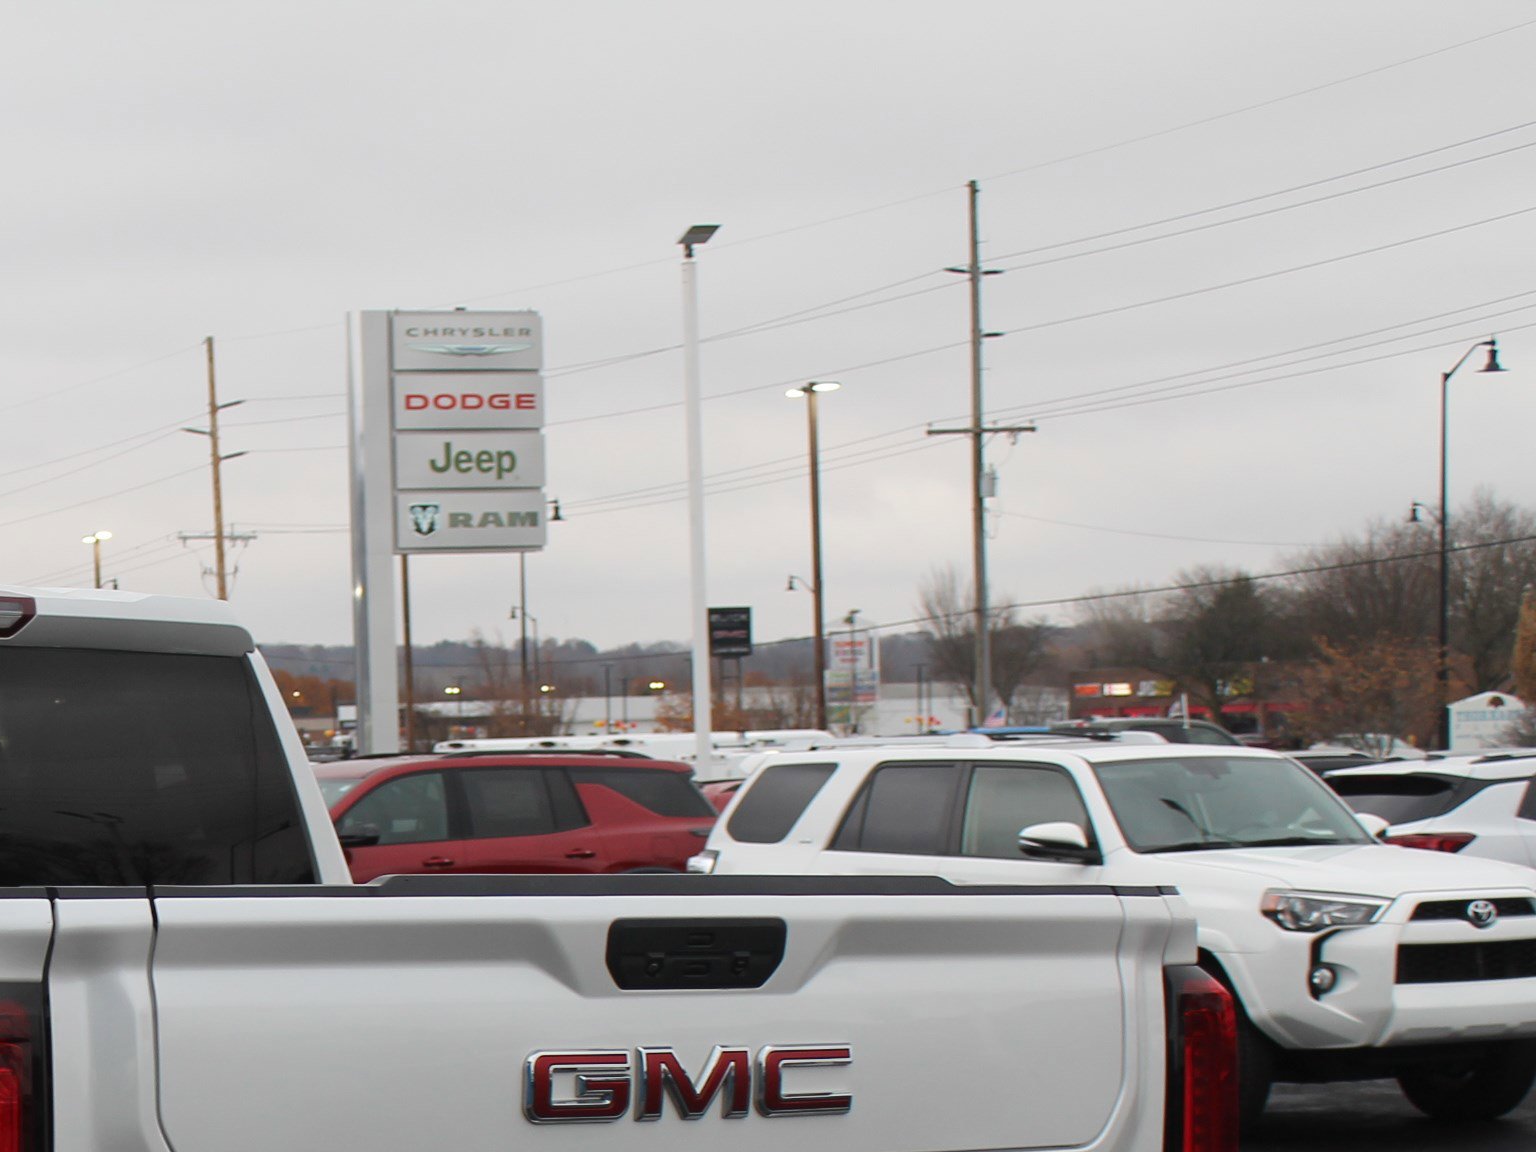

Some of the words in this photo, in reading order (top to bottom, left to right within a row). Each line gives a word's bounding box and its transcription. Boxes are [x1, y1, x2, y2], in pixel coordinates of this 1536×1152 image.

[405, 326, 533, 338] CHRYSLER
[403, 393, 537, 411] DODGE
[429, 441, 518, 480] Jeep
[447, 510, 540, 529] RAM
[522, 1042, 854, 1125] GMC
